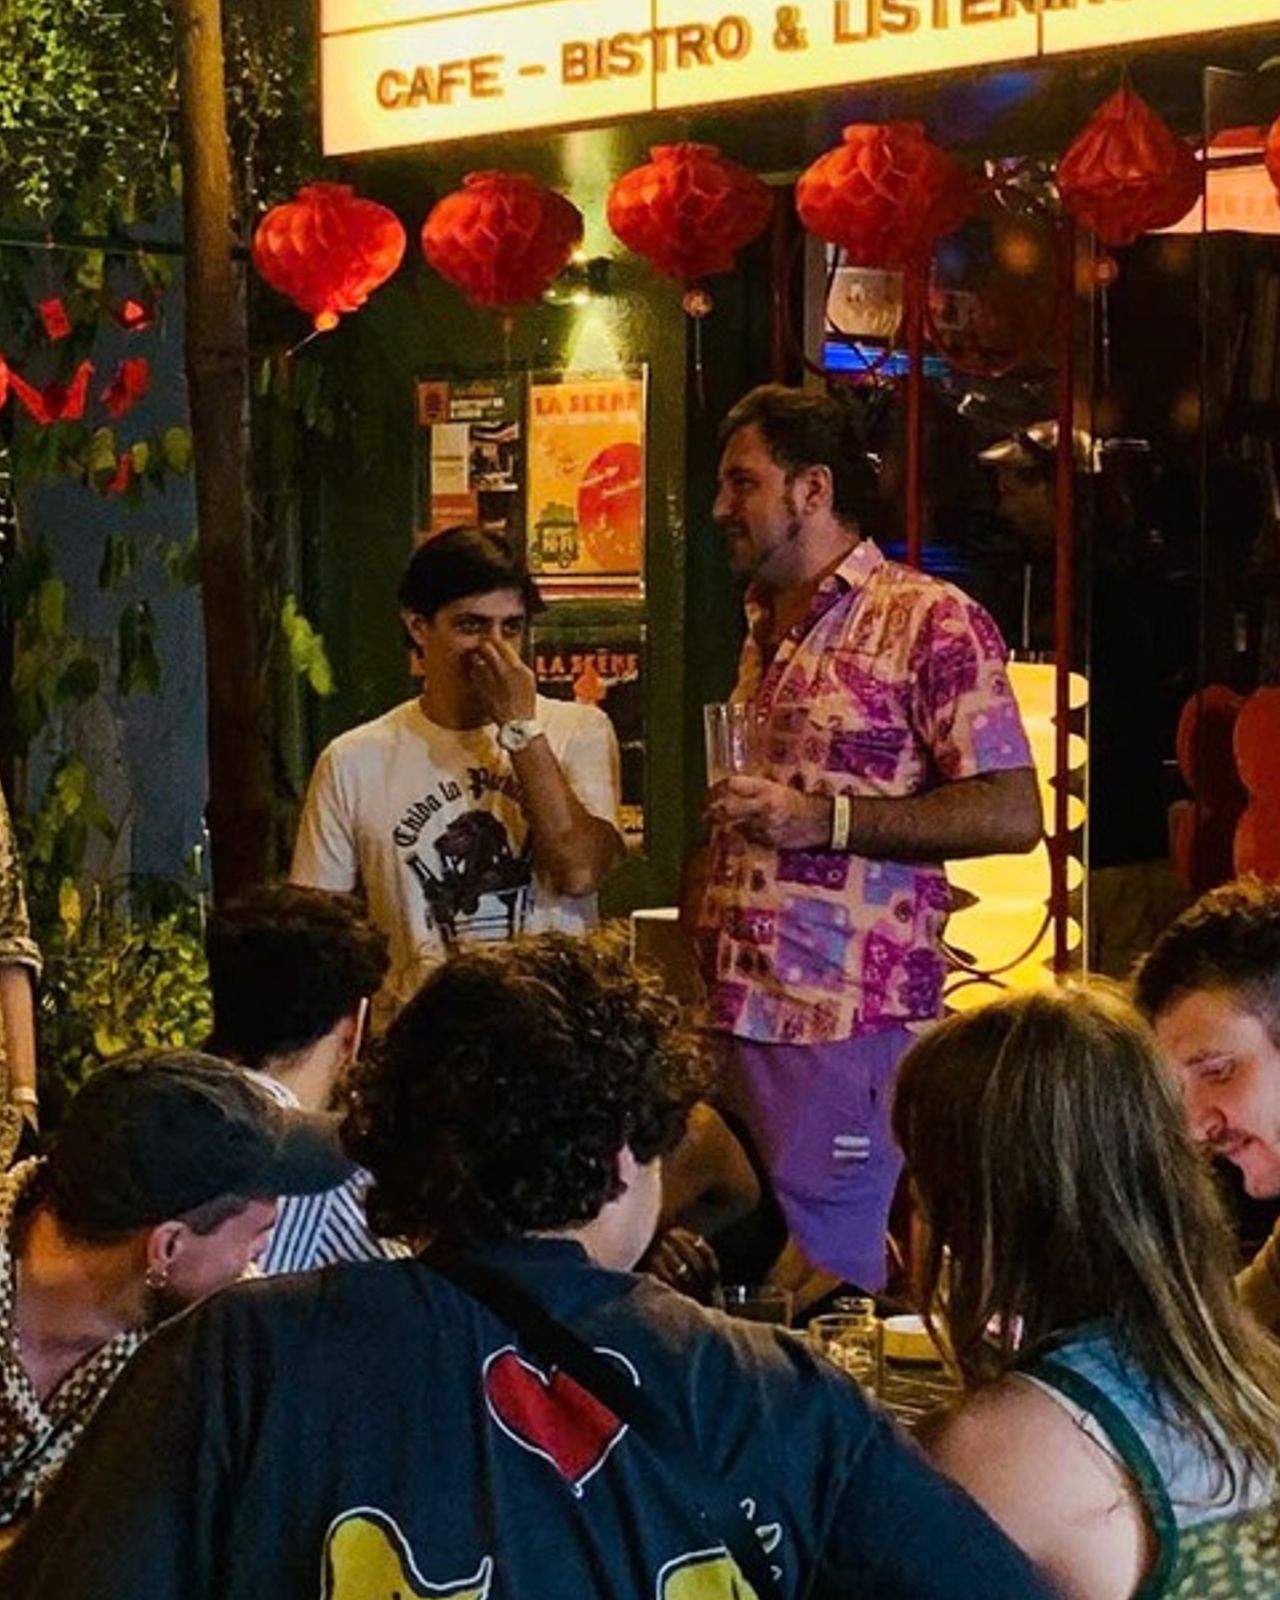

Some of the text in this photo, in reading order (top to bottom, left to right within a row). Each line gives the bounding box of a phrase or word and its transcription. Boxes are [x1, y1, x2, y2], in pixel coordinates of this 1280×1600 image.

[375, 53, 504, 110] CAFE
[562, 15, 751, 86] BISTRO
[772, 4, 809, 52] &
